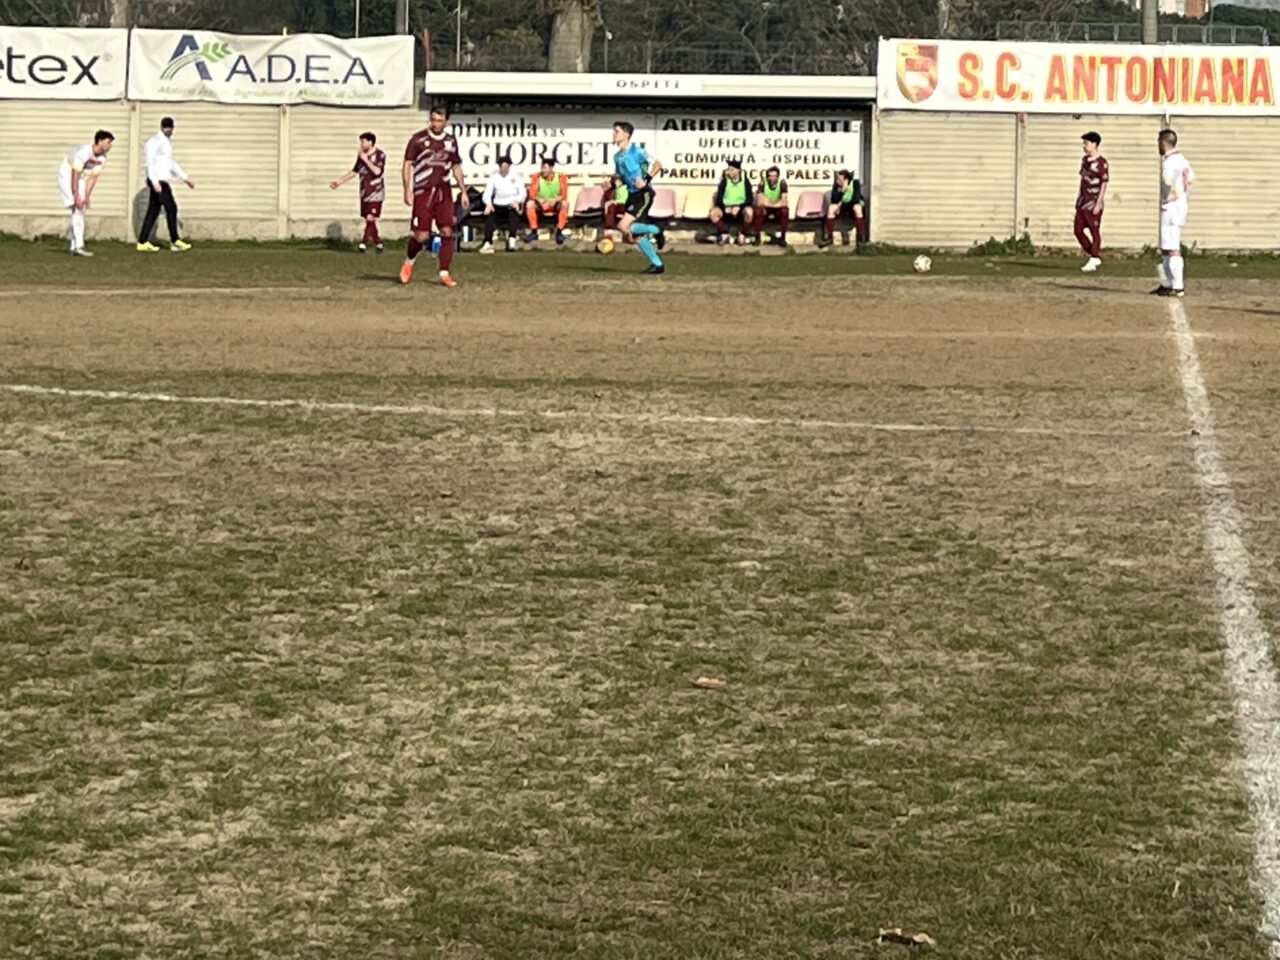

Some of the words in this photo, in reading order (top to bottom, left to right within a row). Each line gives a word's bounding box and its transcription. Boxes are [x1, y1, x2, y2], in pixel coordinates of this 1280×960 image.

[0, 46, 100, 86] tex
[225, 54, 384, 85] A.D.E.A.
[616, 79, 680, 89] OSPITI
[957, 51, 1032, 101] S.C.
[1044, 54, 1274, 106] ANTONIANA
[699, 138, 746, 148] UFFICI
[763, 138, 821, 149] SCUOLE
[660, 168, 715, 180] PARCHI
